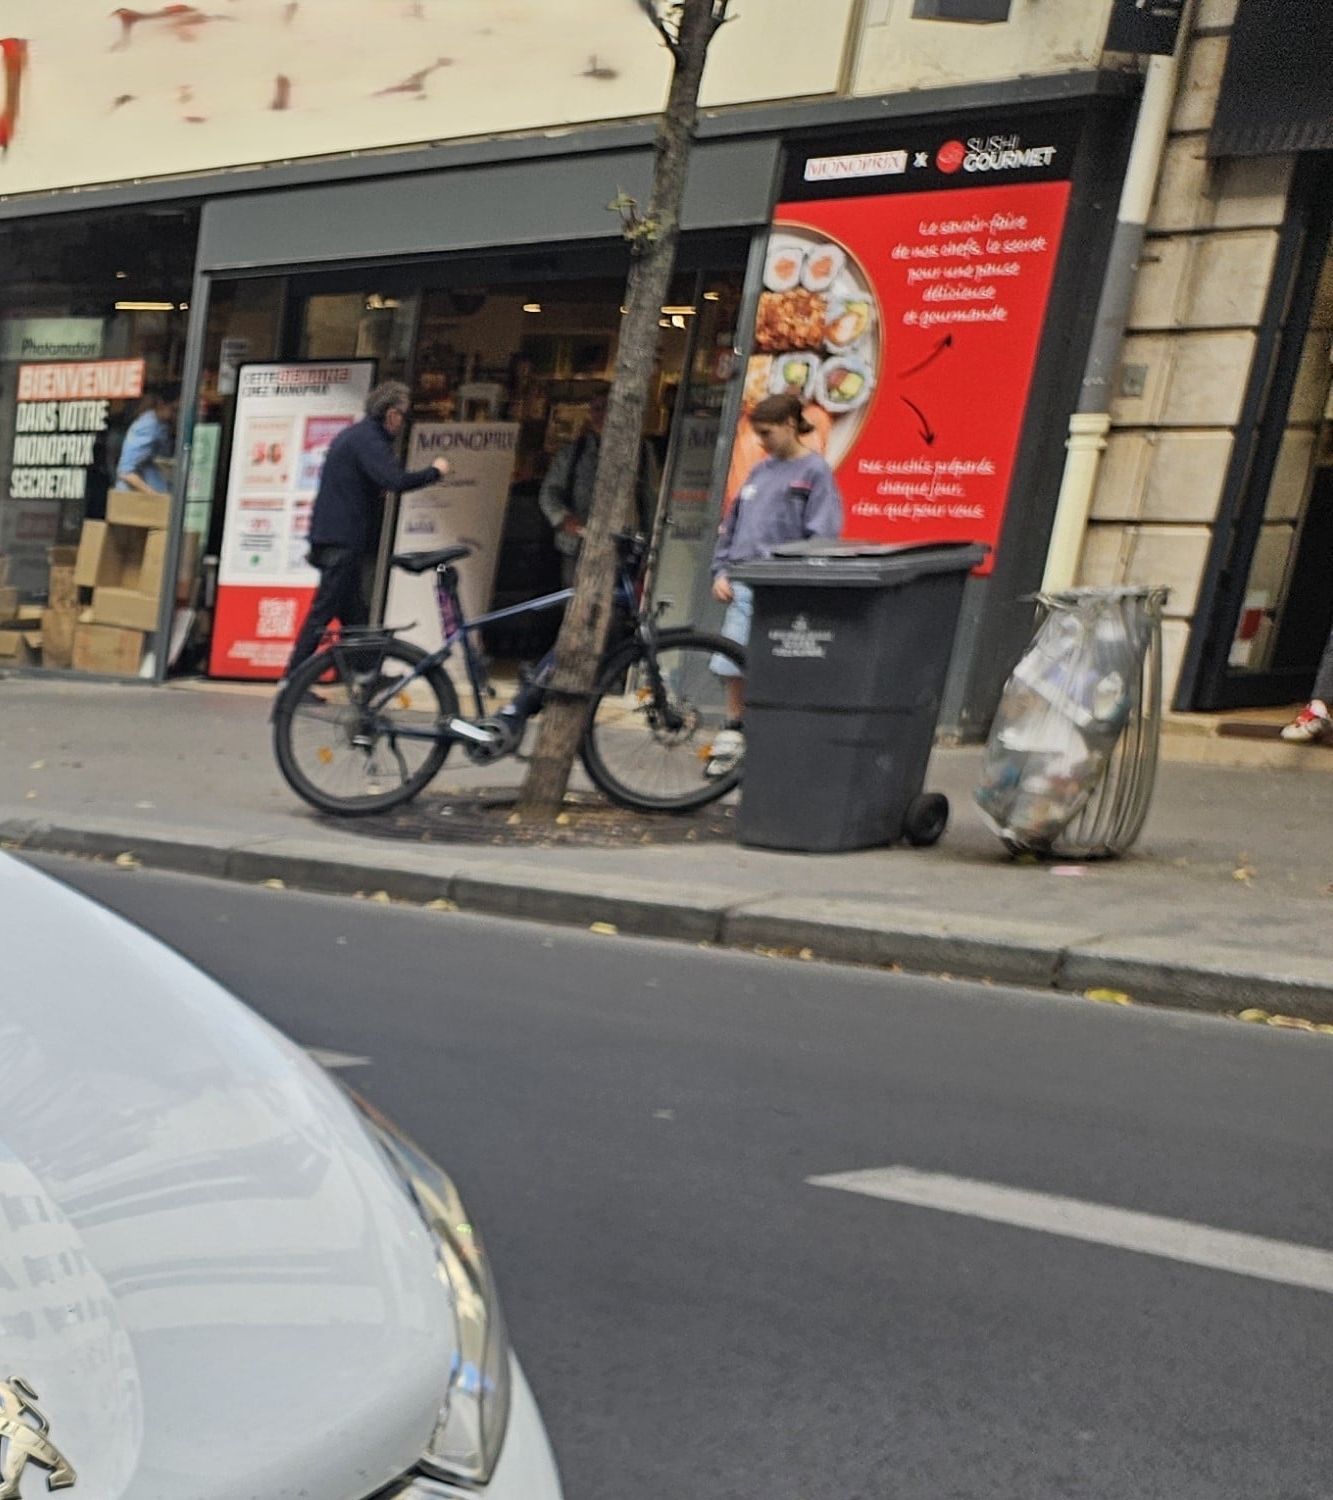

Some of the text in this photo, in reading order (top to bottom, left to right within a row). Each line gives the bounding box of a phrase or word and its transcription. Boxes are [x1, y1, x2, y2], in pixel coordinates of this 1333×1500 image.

[966, 134, 1020, 153] SUSHI
[808, 155, 900, 177] MONOPRIX
[963, 146, 1056, 172] GOURMET
[940, 212, 1027, 236] savoir-faire
[891, 243, 910, 260] de
[1003, 235, 1047, 253] secret
[907, 261, 1021, 286] pour une pause
[919, 304, 1009, 328] gourmande
[20, 361, 141, 399] BIENVENUE
[16, 400, 110, 432] DANS VOTRE
[13, 433, 97, 466] MONOPRIX
[10, 467, 87, 499] SECRETAN
[883, 502, 913, 522] que
[912, 503, 946, 523] pour
